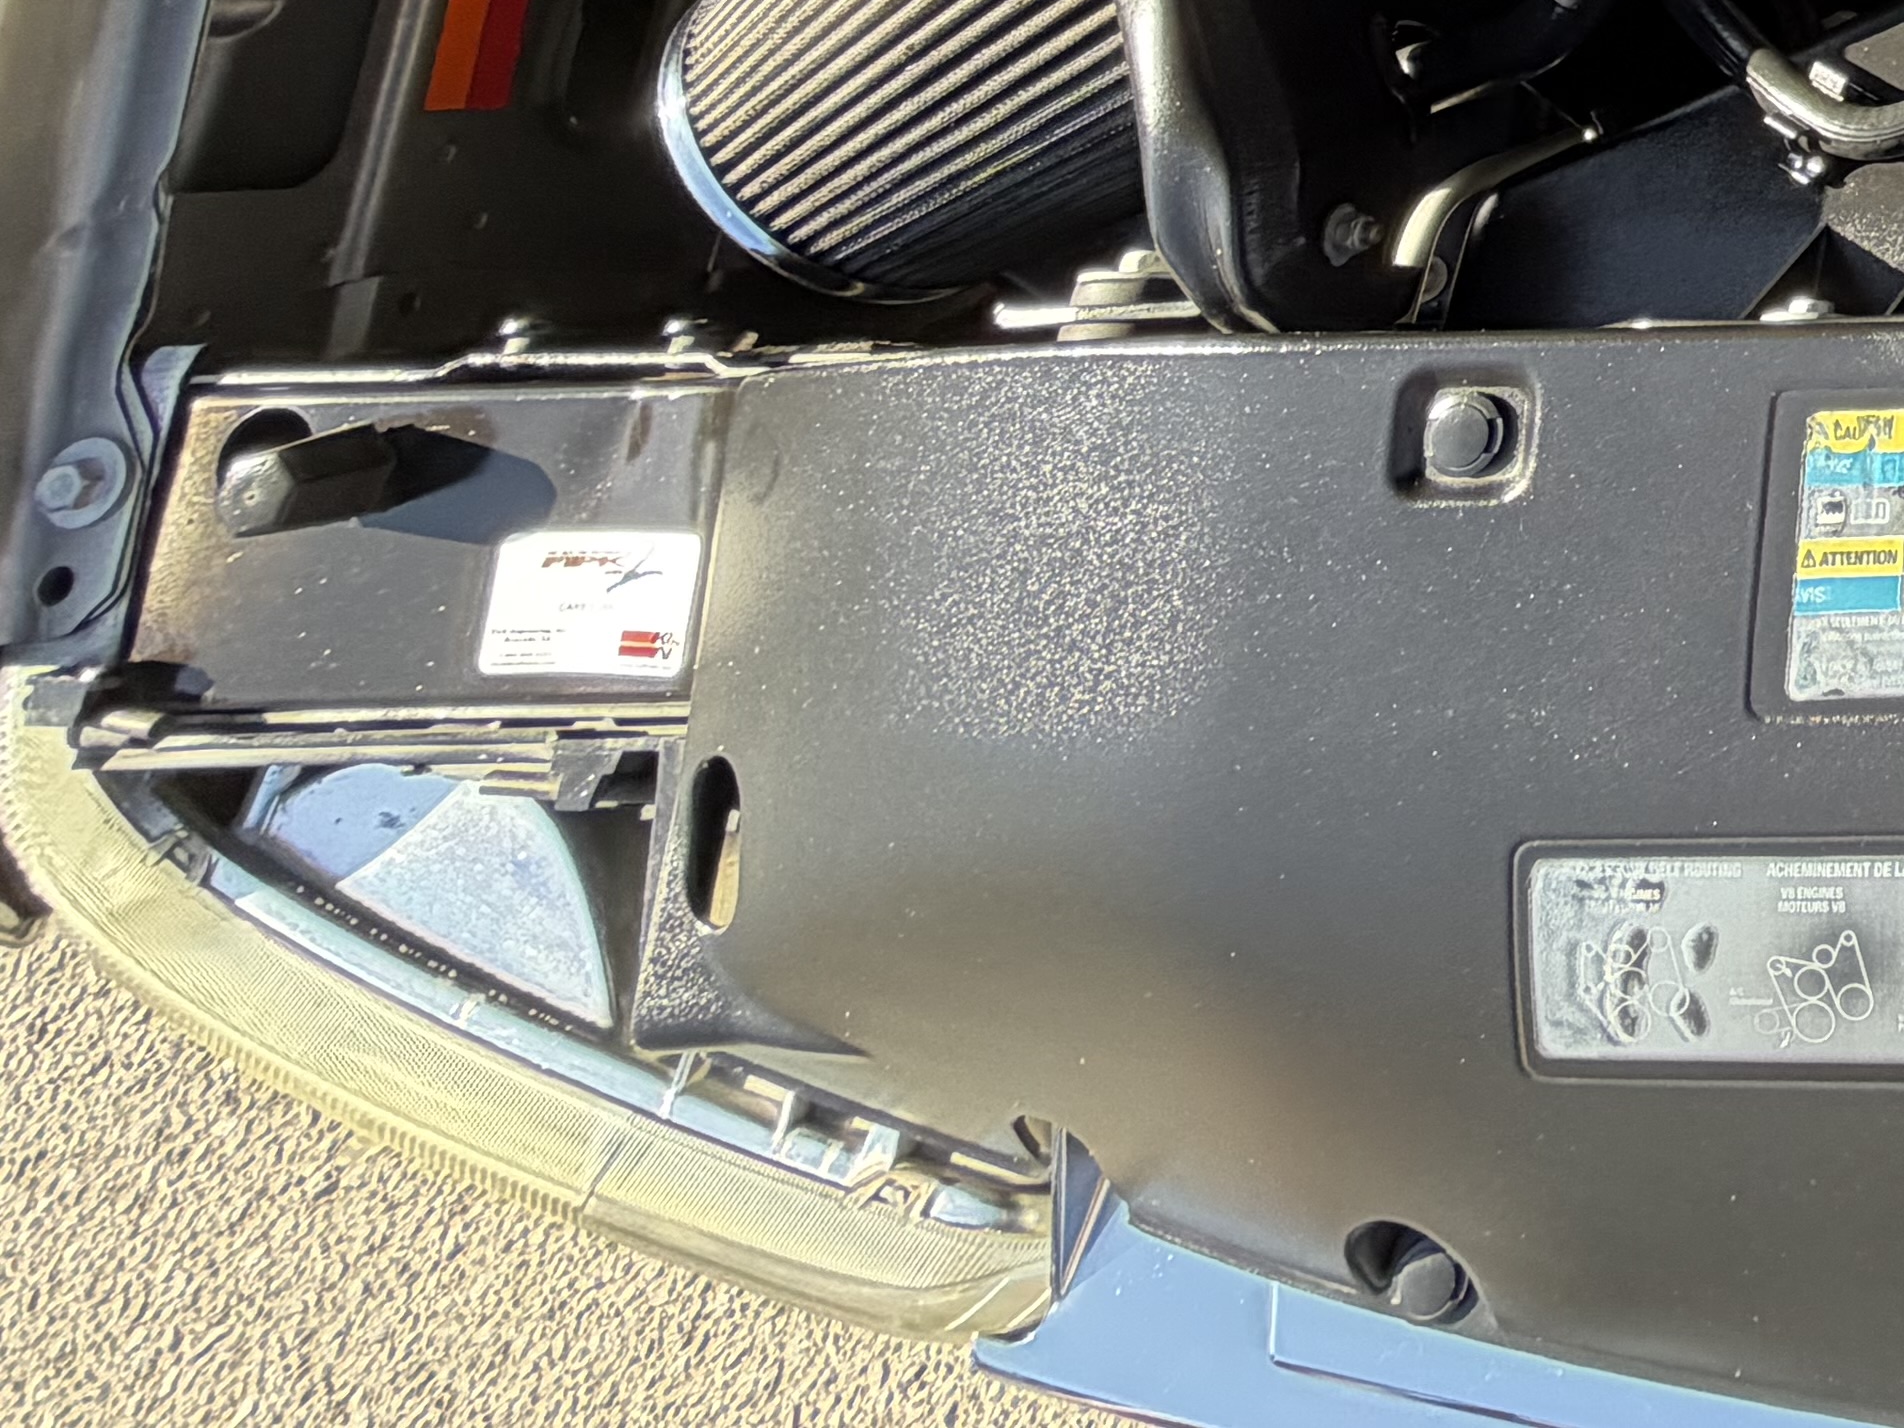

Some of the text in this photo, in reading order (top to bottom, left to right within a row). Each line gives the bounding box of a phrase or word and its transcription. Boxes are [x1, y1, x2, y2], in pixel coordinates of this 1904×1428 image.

[1818, 548, 1898, 568] ATTENTION
[1683, 862, 1742, 878] ROUTING
[1767, 861, 1872, 878] ACHEMINEMENT
[1873, 861, 1892, 878] DE
[1799, 885, 1844, 900] ENGINES
[1777, 899, 1829, 914] MOTEURS
